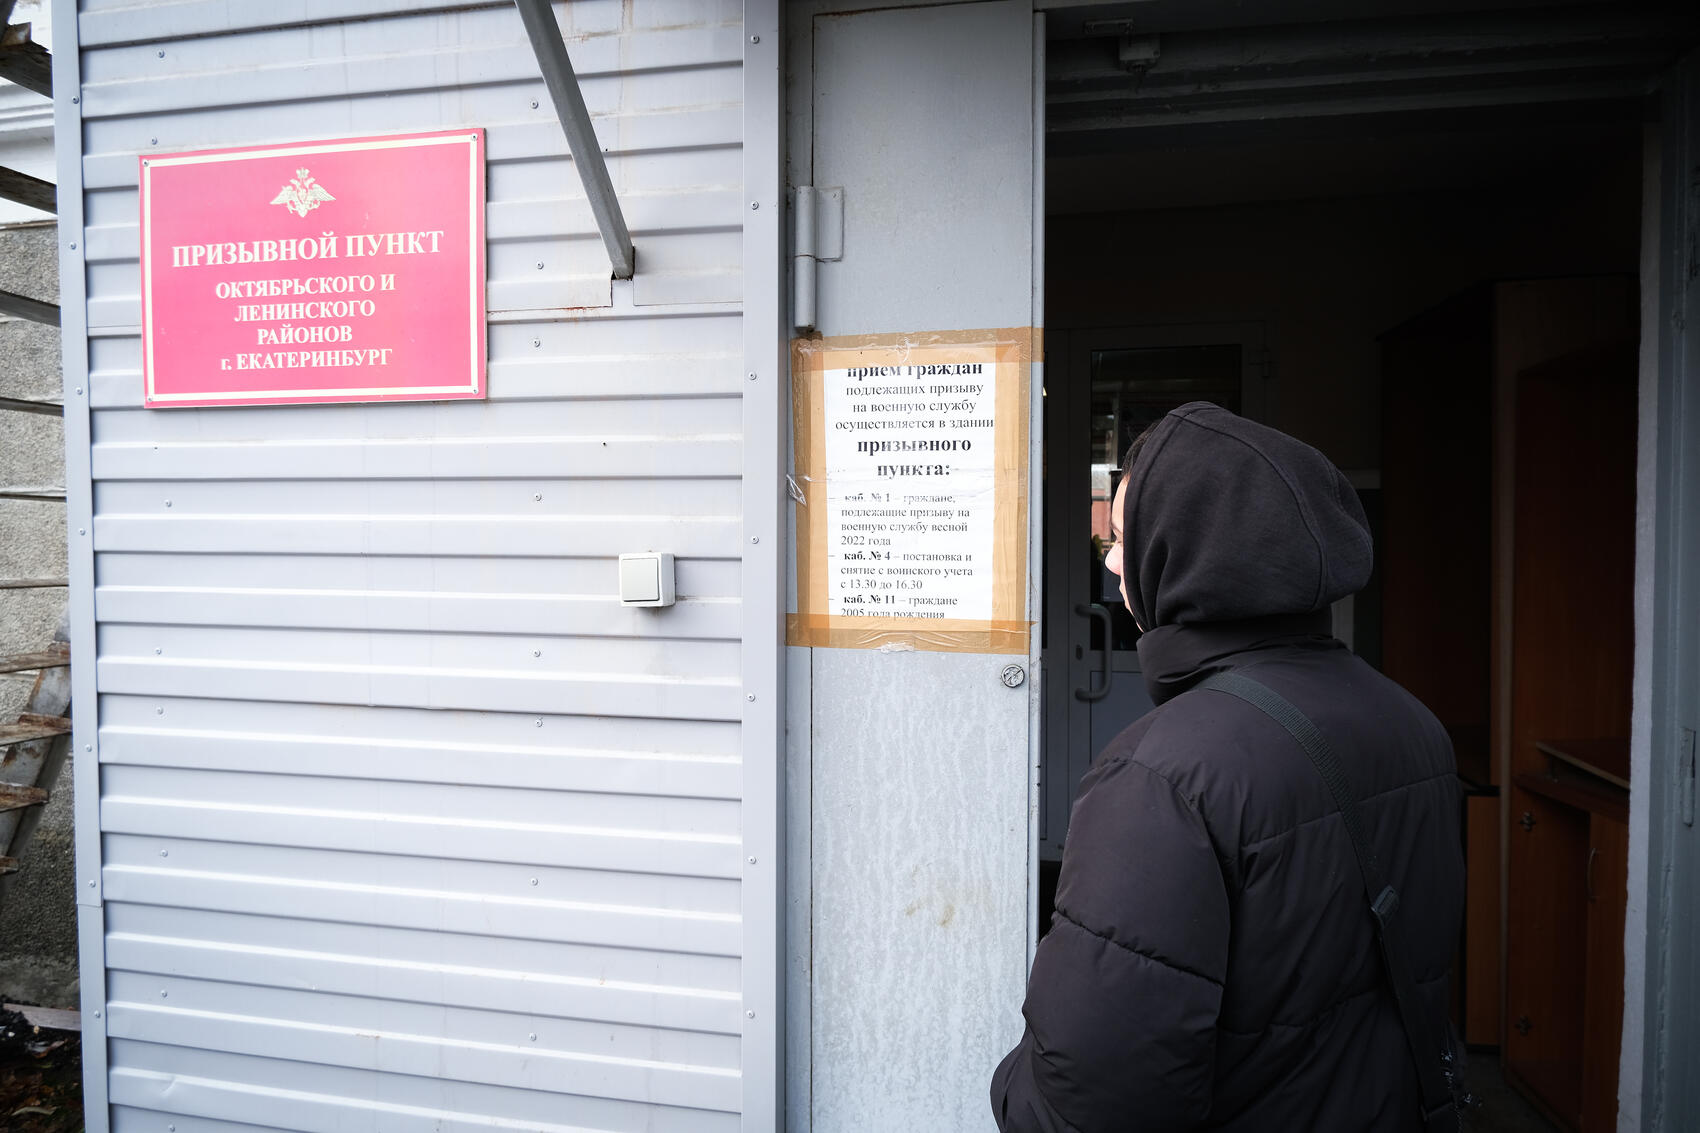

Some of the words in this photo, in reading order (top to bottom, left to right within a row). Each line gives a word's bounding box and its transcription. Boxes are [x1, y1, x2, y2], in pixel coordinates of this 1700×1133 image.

[172, 231, 338, 267] ПРИЗЫВНОЙ
[345, 231, 444, 258] ПУНКТ
[215, 275, 375, 299] ОКТЯБРЬСКОГО
[380, 274, 396, 290] И
[234, 300, 376, 322] ЛЕНИНСКОГО
[257, 324, 353, 345] РАЙОНОВ
[221, 359, 232, 371] г.
[236, 349, 393, 370] ЕКАТЕРИНБУРГ
[907, 364, 983, 380] граждан
[846, 386, 925, 396] подлежащих
[929, 384, 983, 395] призыву
[853, 404, 867, 413] на
[870, 403, 926, 415] военную
[929, 399, 977, 413] службу
[835, 420, 935, 432] осуществляется
[939, 420, 946, 428] в
[949, 419, 994, 429] здании
[857, 439, 972, 456] призывного
[877, 464, 951, 480] пункта:
[885, 492, 891, 502] 1
[841, 509, 907, 518] подлежащие
[909, 508, 955, 519] призыву
[841, 523, 887, 533] военную
[889, 521, 929, 533] службу
[931, 522, 968, 532] весной
[840, 535, 865, 546] 2022
[868, 538, 891, 547] года
[844, 551, 866, 561] каб.
[868, 551, 881, 561] №
[884, 552, 891, 561] 4
[903, 553, 962, 562] постановка
[840, 567, 876, 576] снятие
[887, 567, 941, 576] воинского
[944, 567, 973, 578] учета
[840, 581, 846, 589] с
[850, 579, 877, 589] 13.30
[879, 581, 893, 591] до
[896, 580, 923, 590] 16.30
[844, 594, 866, 604] каб.
[868, 594, 881, 604] №
[884, 595, 896, 604] 11
[908, 597, 958, 606] граждане
[840, 608, 865, 618] 2005
[893, 610, 945, 619] рождения
